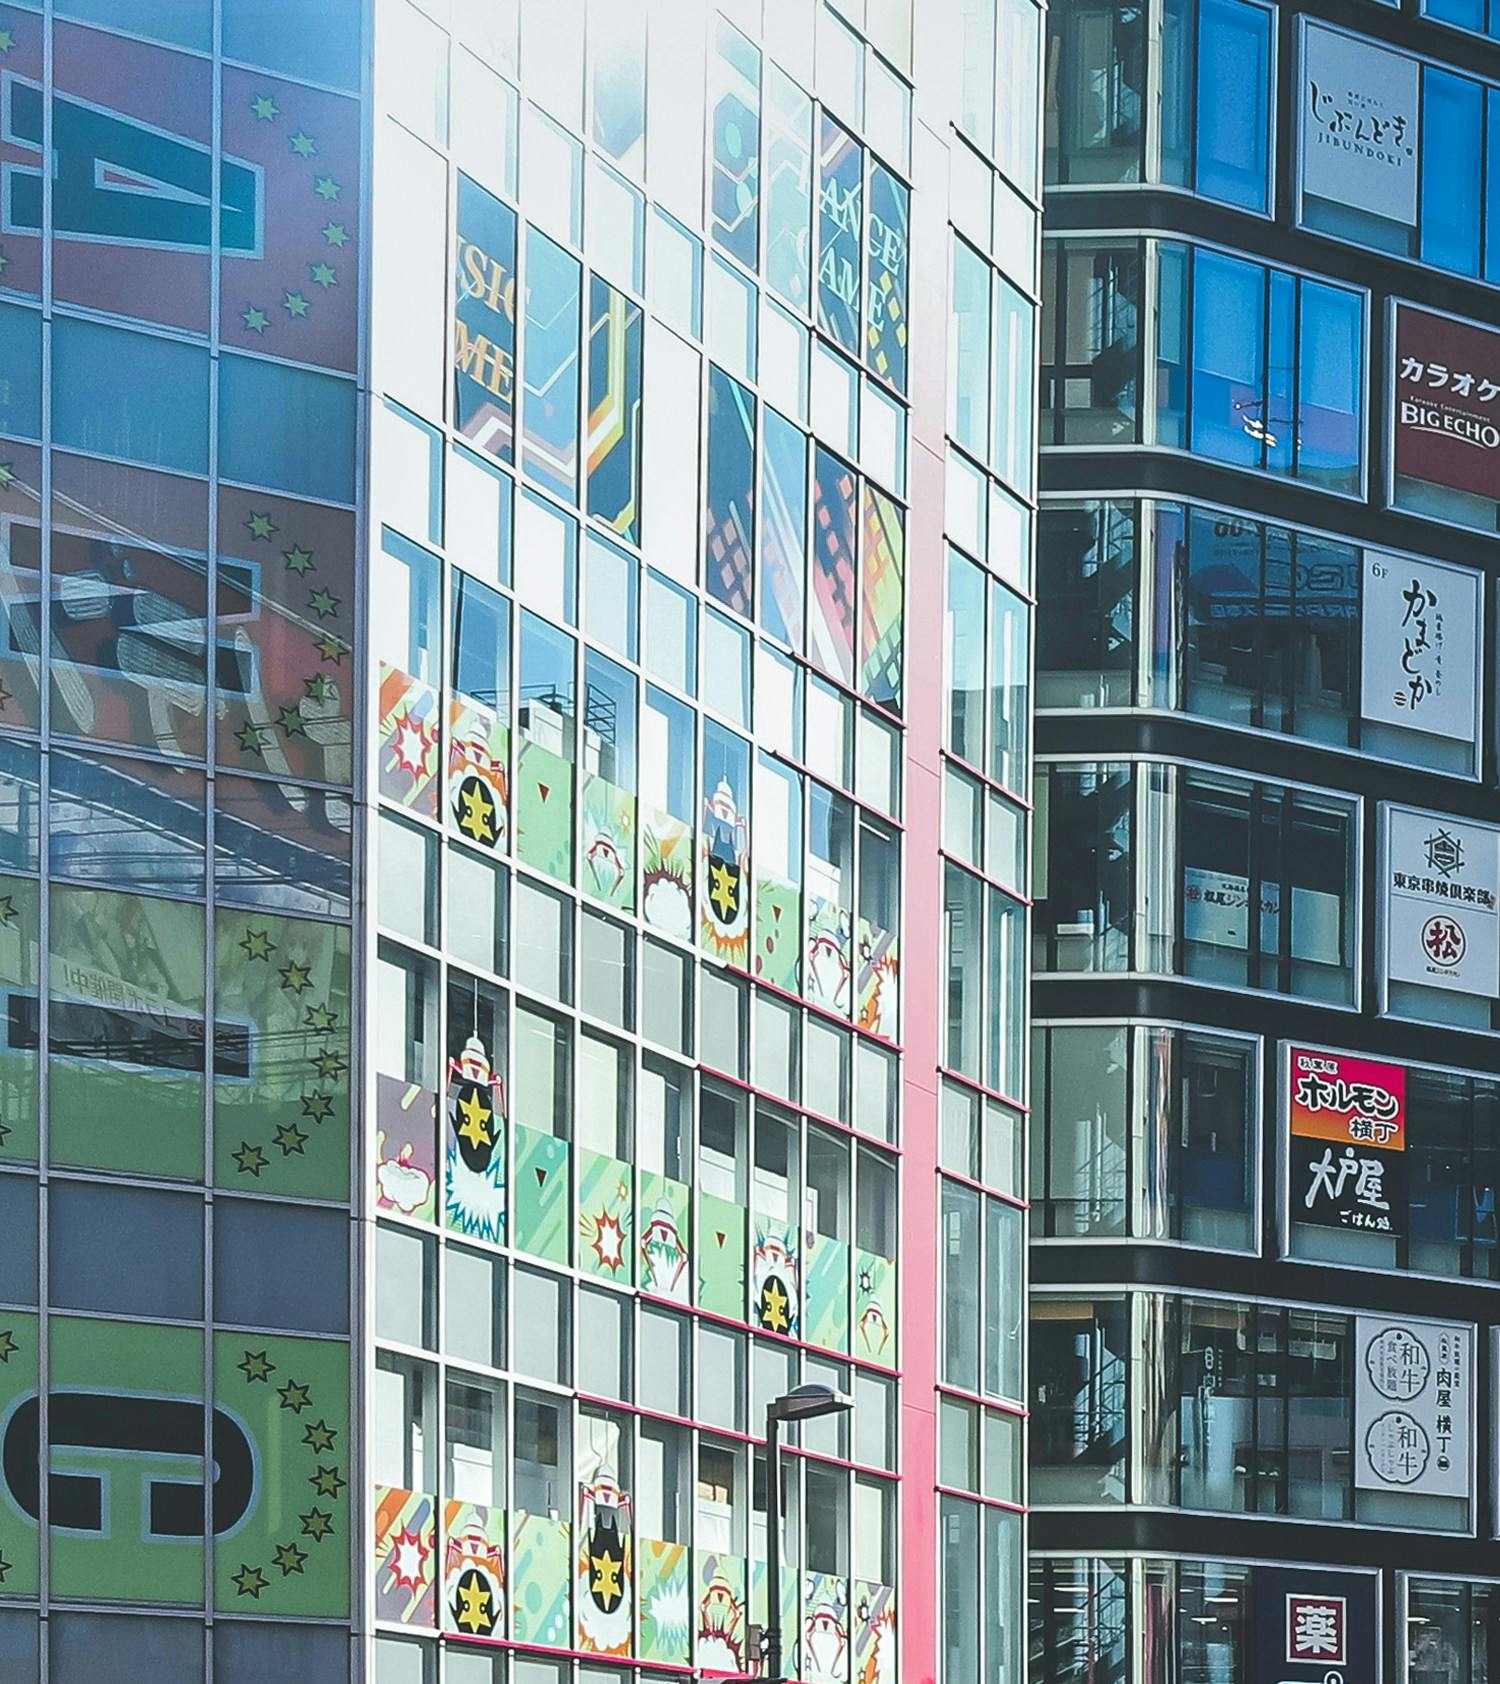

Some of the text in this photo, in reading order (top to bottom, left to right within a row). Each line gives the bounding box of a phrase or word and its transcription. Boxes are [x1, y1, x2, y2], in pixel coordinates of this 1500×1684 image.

[1317, 131, 1403, 168] JIBUNDOKI
[1401, 401, 1500, 448] BIG ECHO
[1371, 562, 1390, 580] 6F
[1401, 578, 1438, 711] かまどか
[1425, 921, 1462, 960] 松
[1296, 1074, 1398, 1119] ホルモン
[1350, 1116, 1398, 1142] 横丁
[1305, 1147, 1390, 1210] 大戸屋
[1399, 1341, 1420, 1393] 和牛
[1396, 1426, 1417, 1477] 和牛
[1294, 1605, 1339, 1654] 薬
